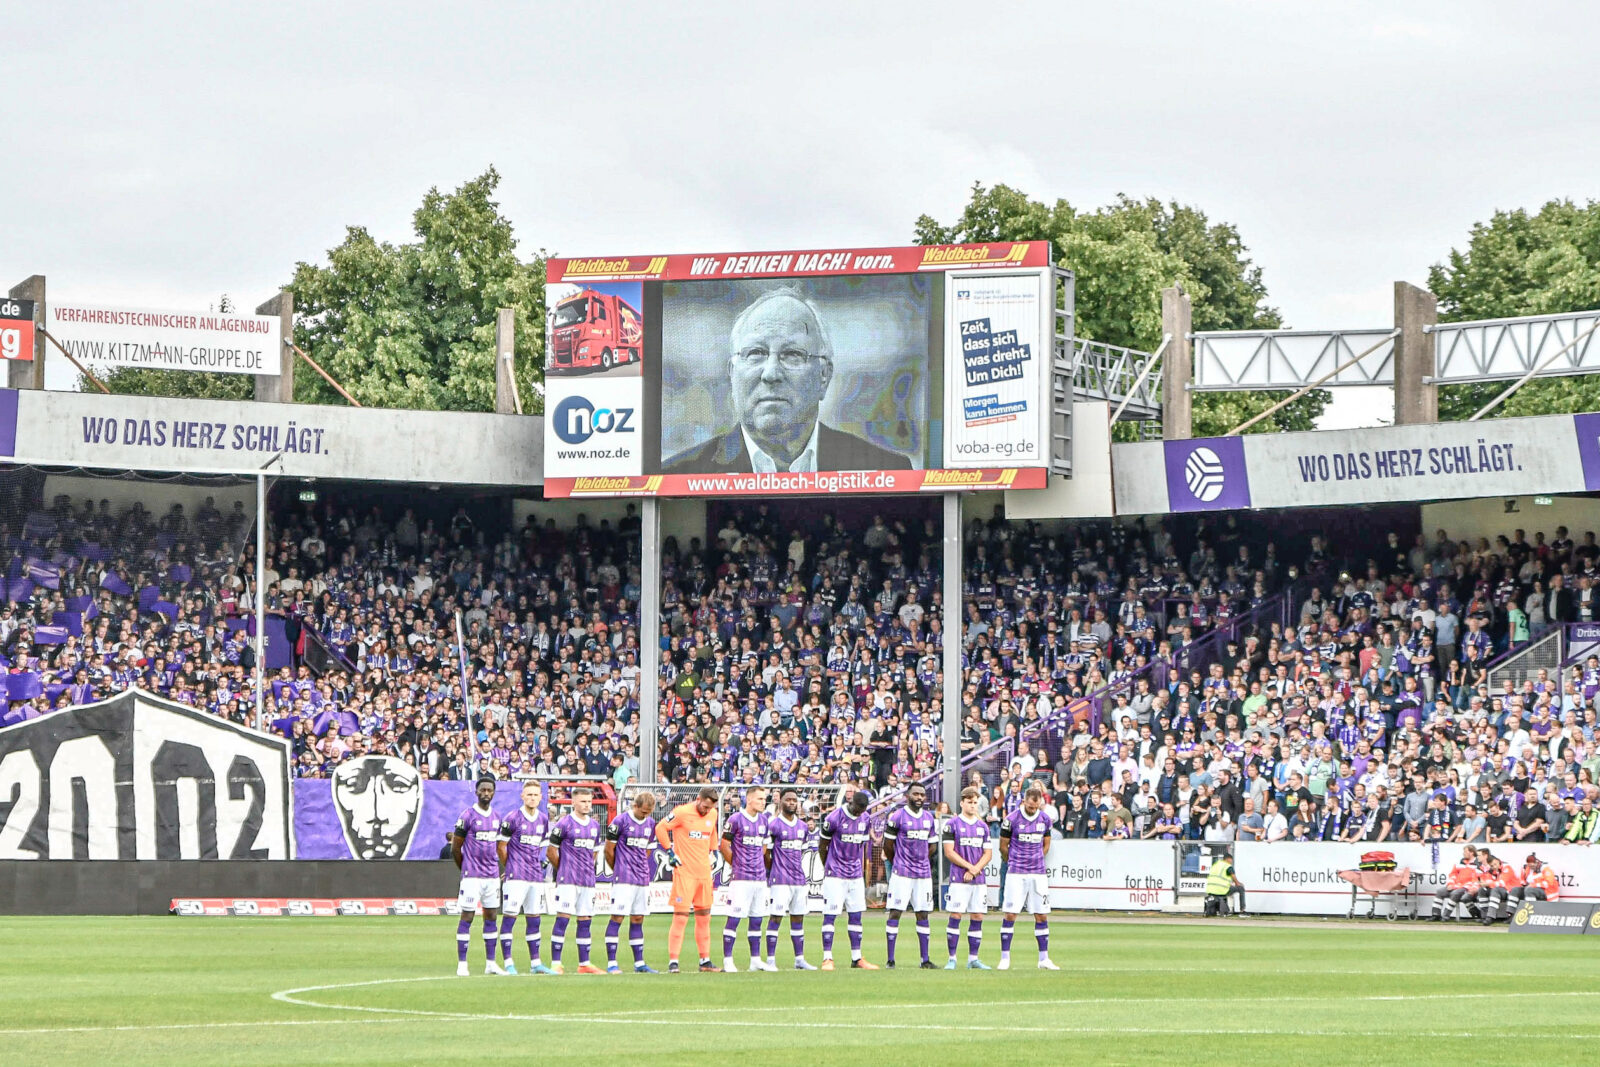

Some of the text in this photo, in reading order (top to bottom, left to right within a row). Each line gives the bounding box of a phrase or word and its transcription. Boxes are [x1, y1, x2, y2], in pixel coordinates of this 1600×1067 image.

[923, 245, 989, 261] Waldbach
[566, 258, 629, 273] Waldbach
[690, 252, 895, 275] Wir DENKEN NACH! vorn.
[55, 307, 270, 334] VERFAHRENSTECHNISCHER ANLAGENBAU
[961, 321, 988, 335] Zeit,
[964, 332, 1015, 351] dass sich
[62, 340, 262, 369] WWW.KITZMANN-GRUPPE.DE
[965, 347, 1029, 367] was dreht.
[967, 364, 1022, 383] Um Dich!
[964, 397, 997, 409] Morgen
[965, 404, 1026, 419] kann kommen.
[82, 416, 329, 455] WO DAS HERZ SCHLÄGT.
[557, 447, 630, 459] www.noz.de
[956, 438, 1034, 457] voba-eg.de
[1298, 438, 1523, 482] WO DAS HERZ SCHLÄGT.
[574, 476, 630, 489] Waldbach
[687, 472, 895, 493] www.waldbach-logistik.de
[924, 469, 982, 483] Waldbach
[1046, 865, 1102, 881] er Region
[1125, 875, 1163, 889] for the
[1129, 888, 1159, 906] night
[1566, 916, 1586, 927] WELZ
